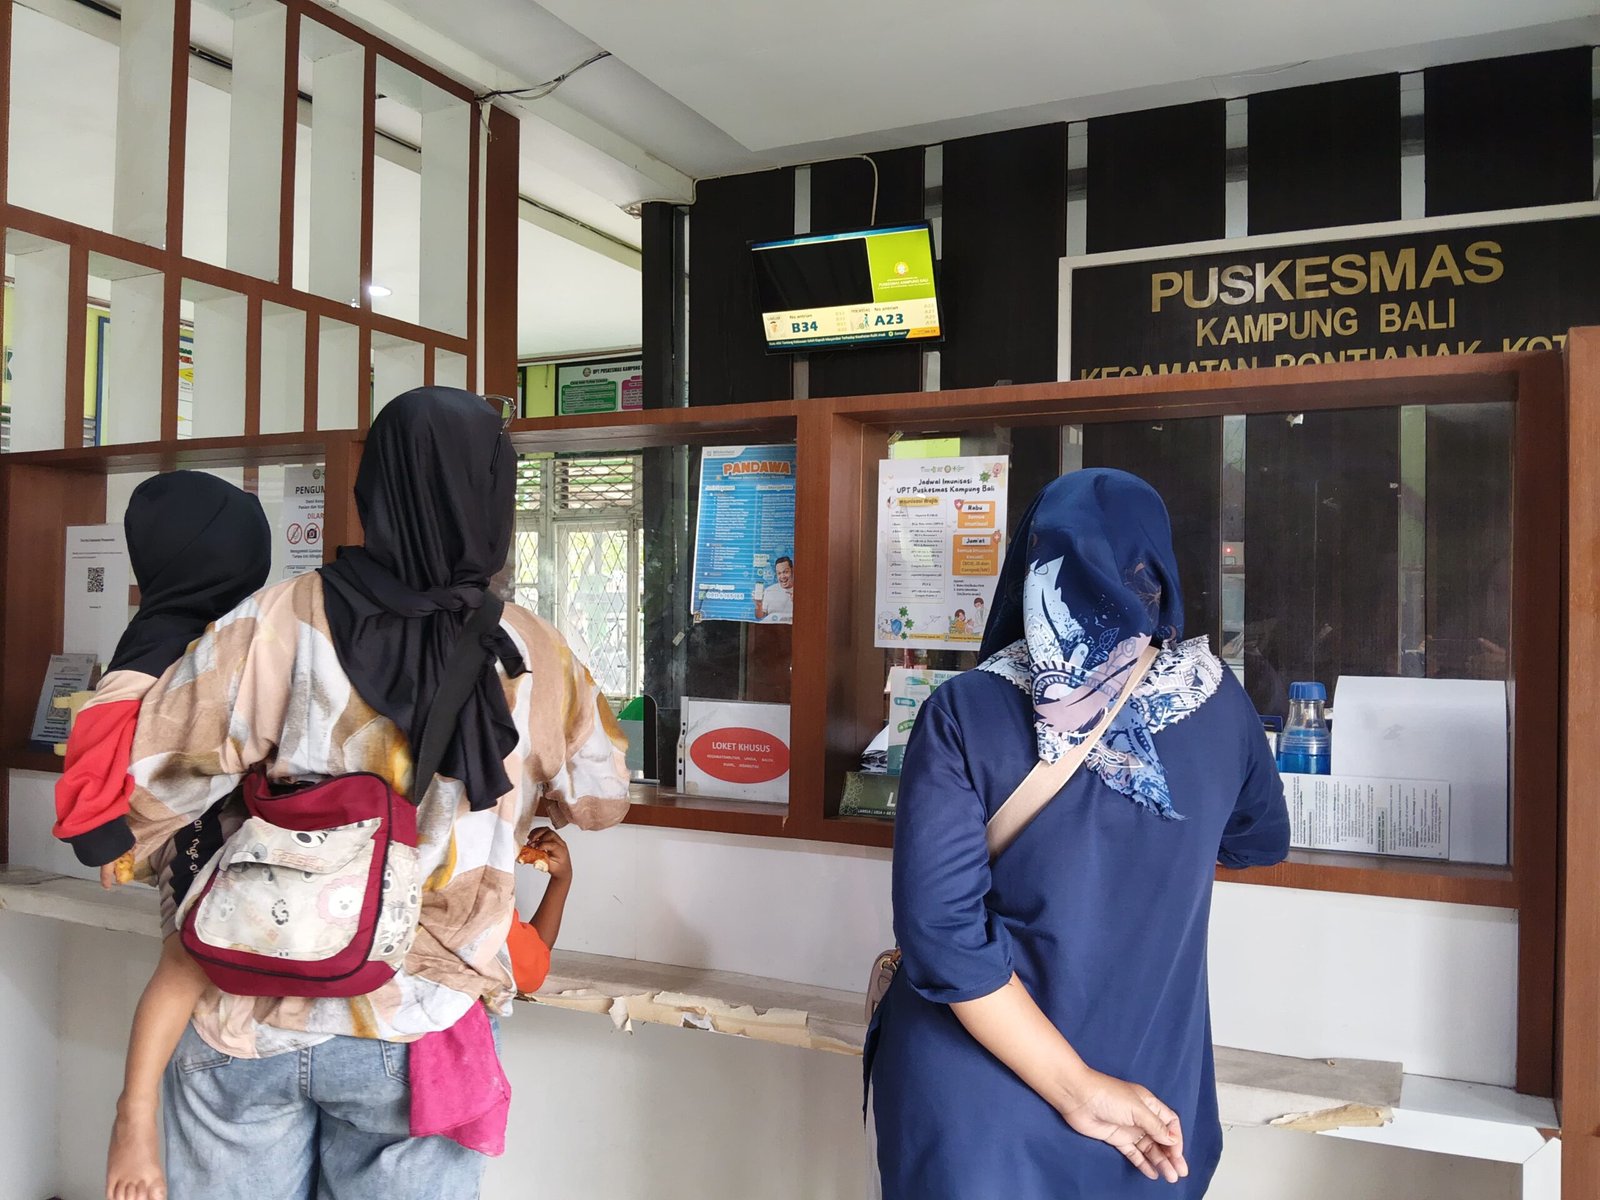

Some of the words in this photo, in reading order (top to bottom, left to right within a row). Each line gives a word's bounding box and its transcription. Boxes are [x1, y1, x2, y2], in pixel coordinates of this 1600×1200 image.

[1151, 241, 1505, 314] PUSKESMAS
[874, 313, 904, 327] A23
[1196, 308, 1359, 348] KAMPUNG
[1379, 298, 1456, 335] BALI
[792, 321, 819, 334] B34
[723, 461, 791, 476] PANDAWA
[918, 478, 941, 486] Jadwal
[942, 477, 972, 485] Imunisasi
[896, 486, 910, 494] UPT
[912, 486, 948, 494] Puskesmas
[949, 485, 981, 495] Kampung
[982, 485, 995, 493] Bali
[712, 741, 736, 750] LOKET
[738, 743, 770, 752] KHUSUS
